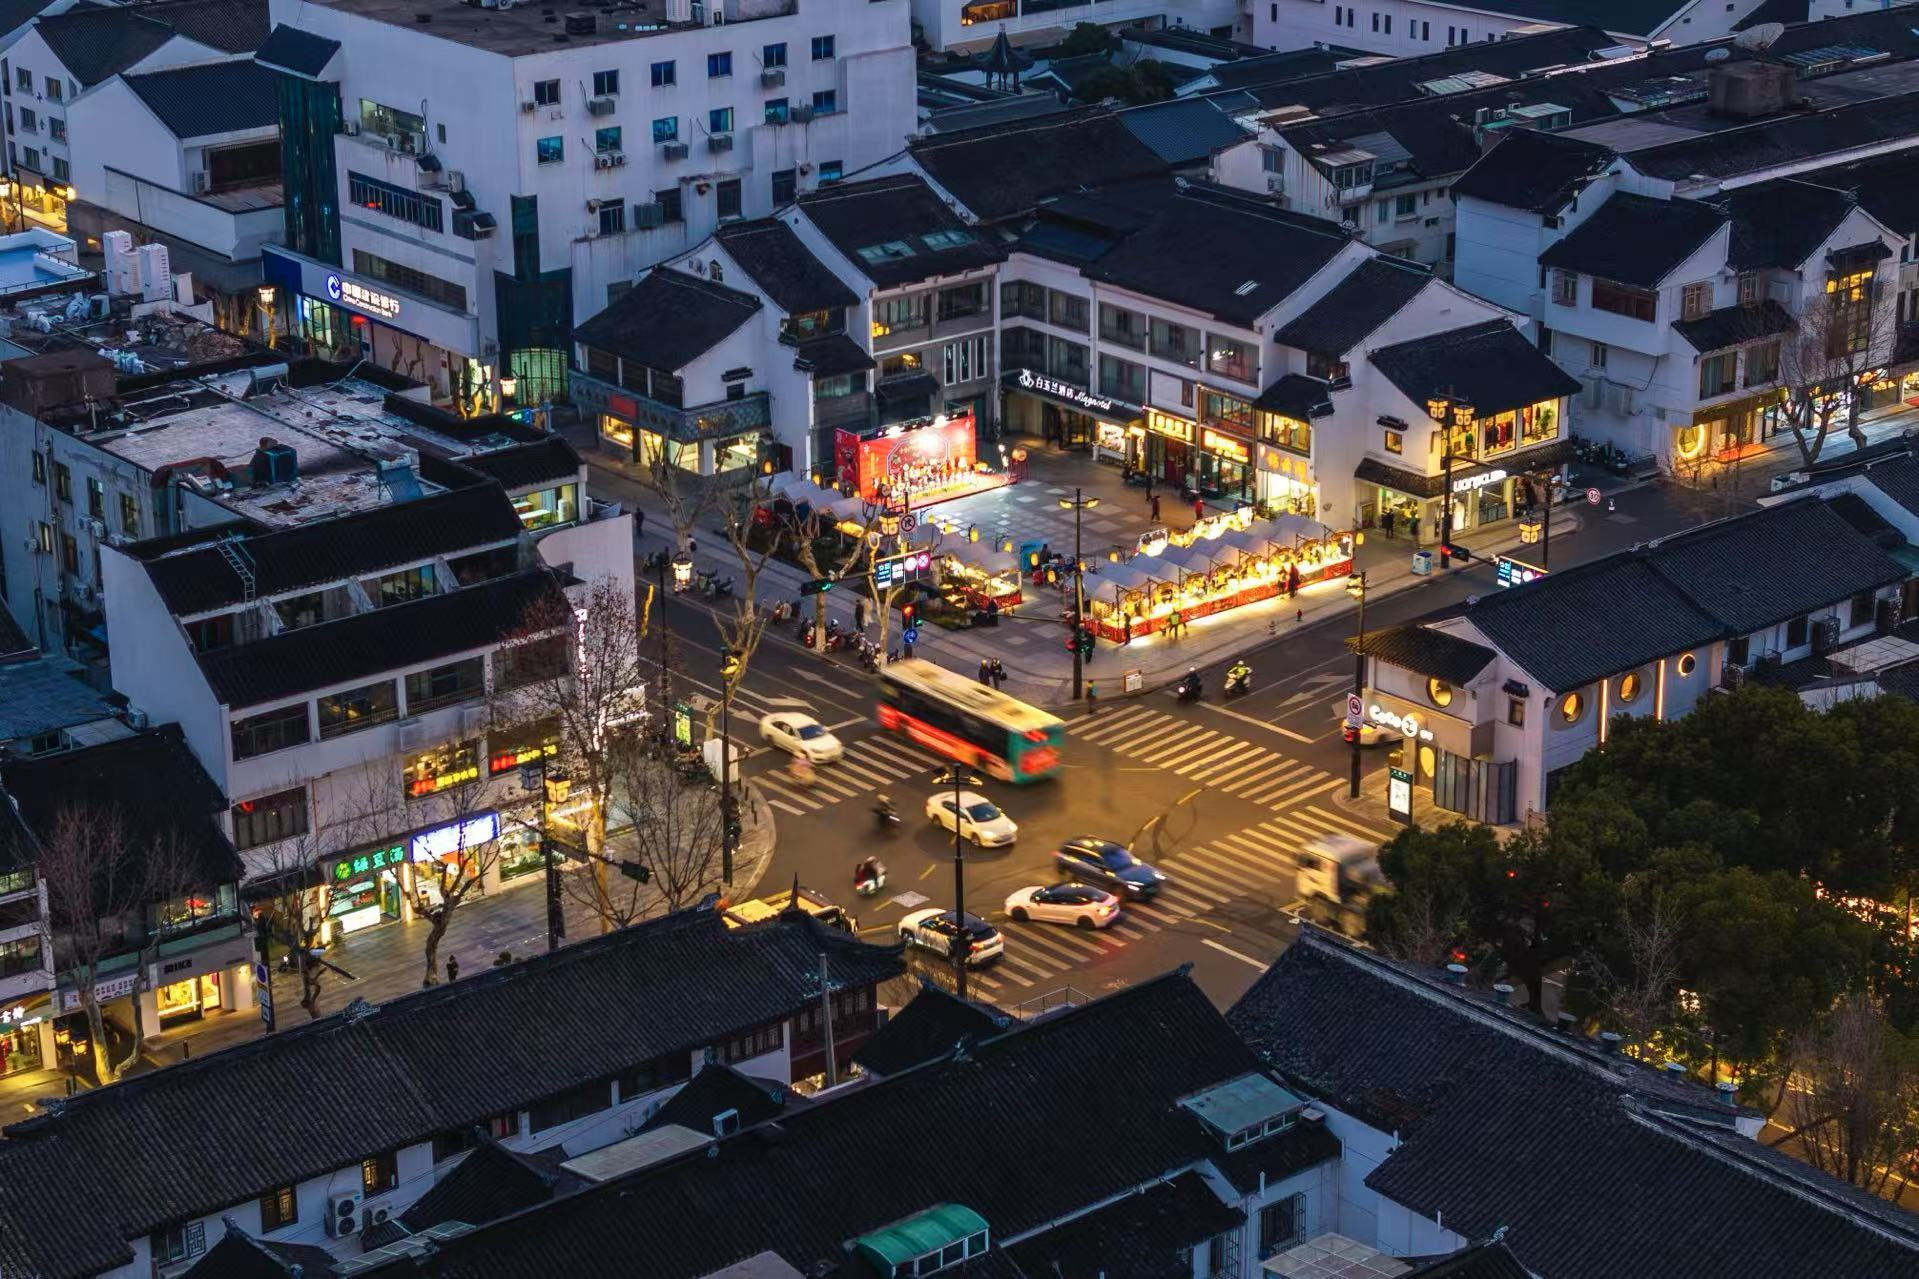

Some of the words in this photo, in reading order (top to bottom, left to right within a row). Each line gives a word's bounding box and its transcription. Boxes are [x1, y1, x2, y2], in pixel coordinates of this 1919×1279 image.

[1035, 376, 1074, 399] 白玉兰酒店
[1074, 391, 1112, 411] Magnotel
